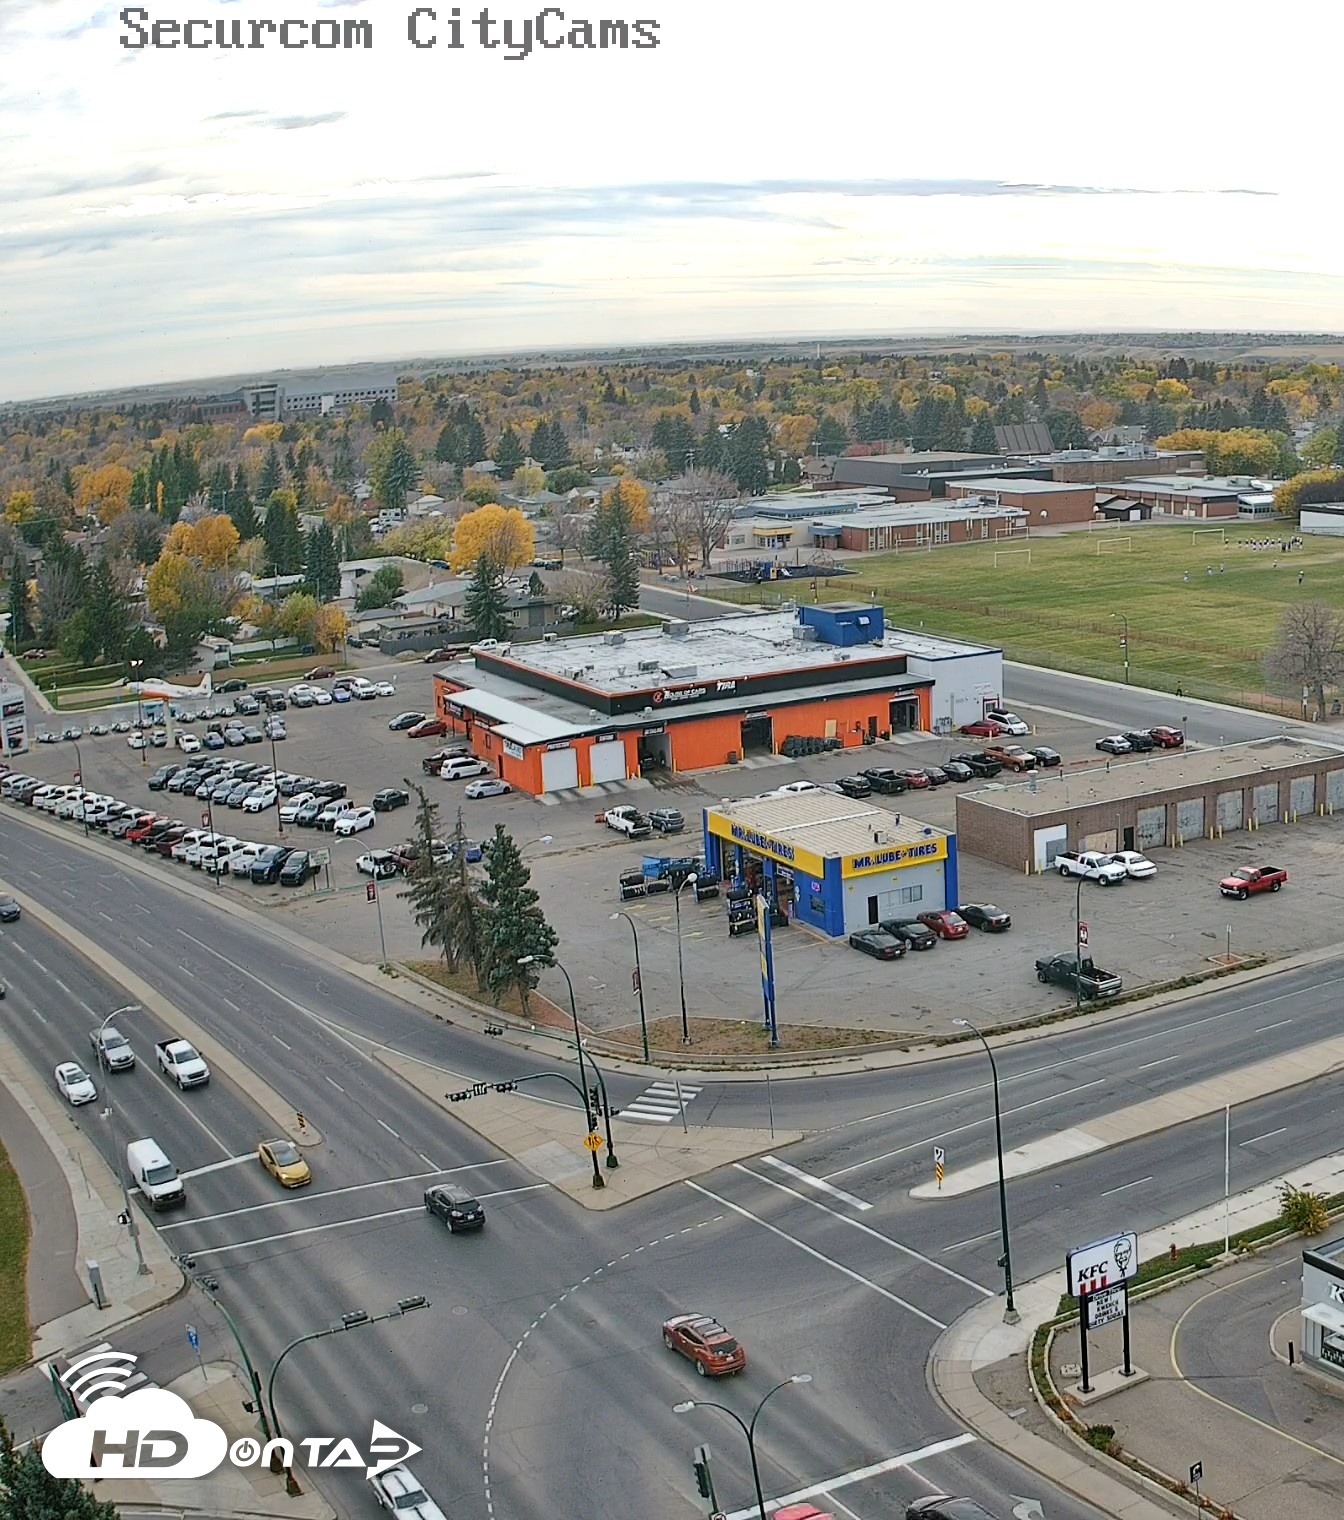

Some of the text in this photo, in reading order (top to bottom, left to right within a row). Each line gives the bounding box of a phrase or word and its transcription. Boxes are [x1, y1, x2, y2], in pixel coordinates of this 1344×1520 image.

[747, 830, 767, 850] LUBE
[876, 850, 901, 865] LUBE
[908, 843, 938, 858] TIRES
[1077, 1261, 1108, 1282] KFC
